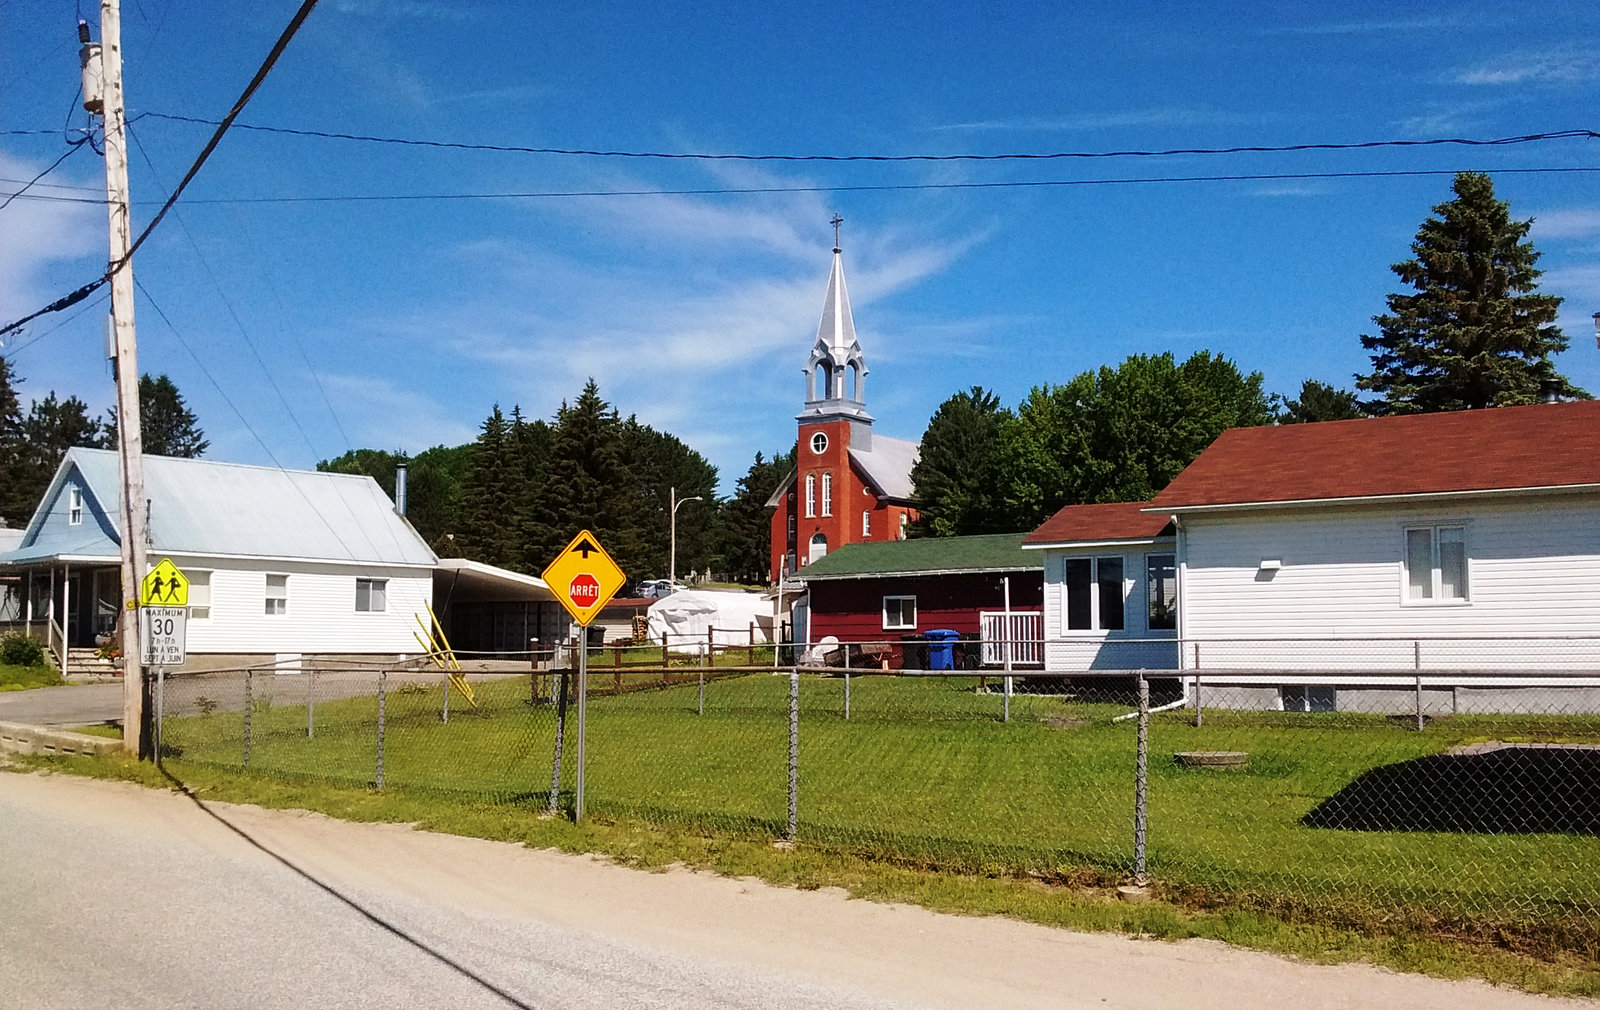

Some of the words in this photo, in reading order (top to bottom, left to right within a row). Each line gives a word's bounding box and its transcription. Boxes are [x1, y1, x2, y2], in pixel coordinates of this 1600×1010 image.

[571, 584, 598, 596] ARRÊT
[153, 619, 173, 635] 30
[147, 645, 159, 653] LUN
[167, 645, 179, 653] VEN
[144, 654, 159, 662] SEPT
[168, 654, 181, 662] JUIN
